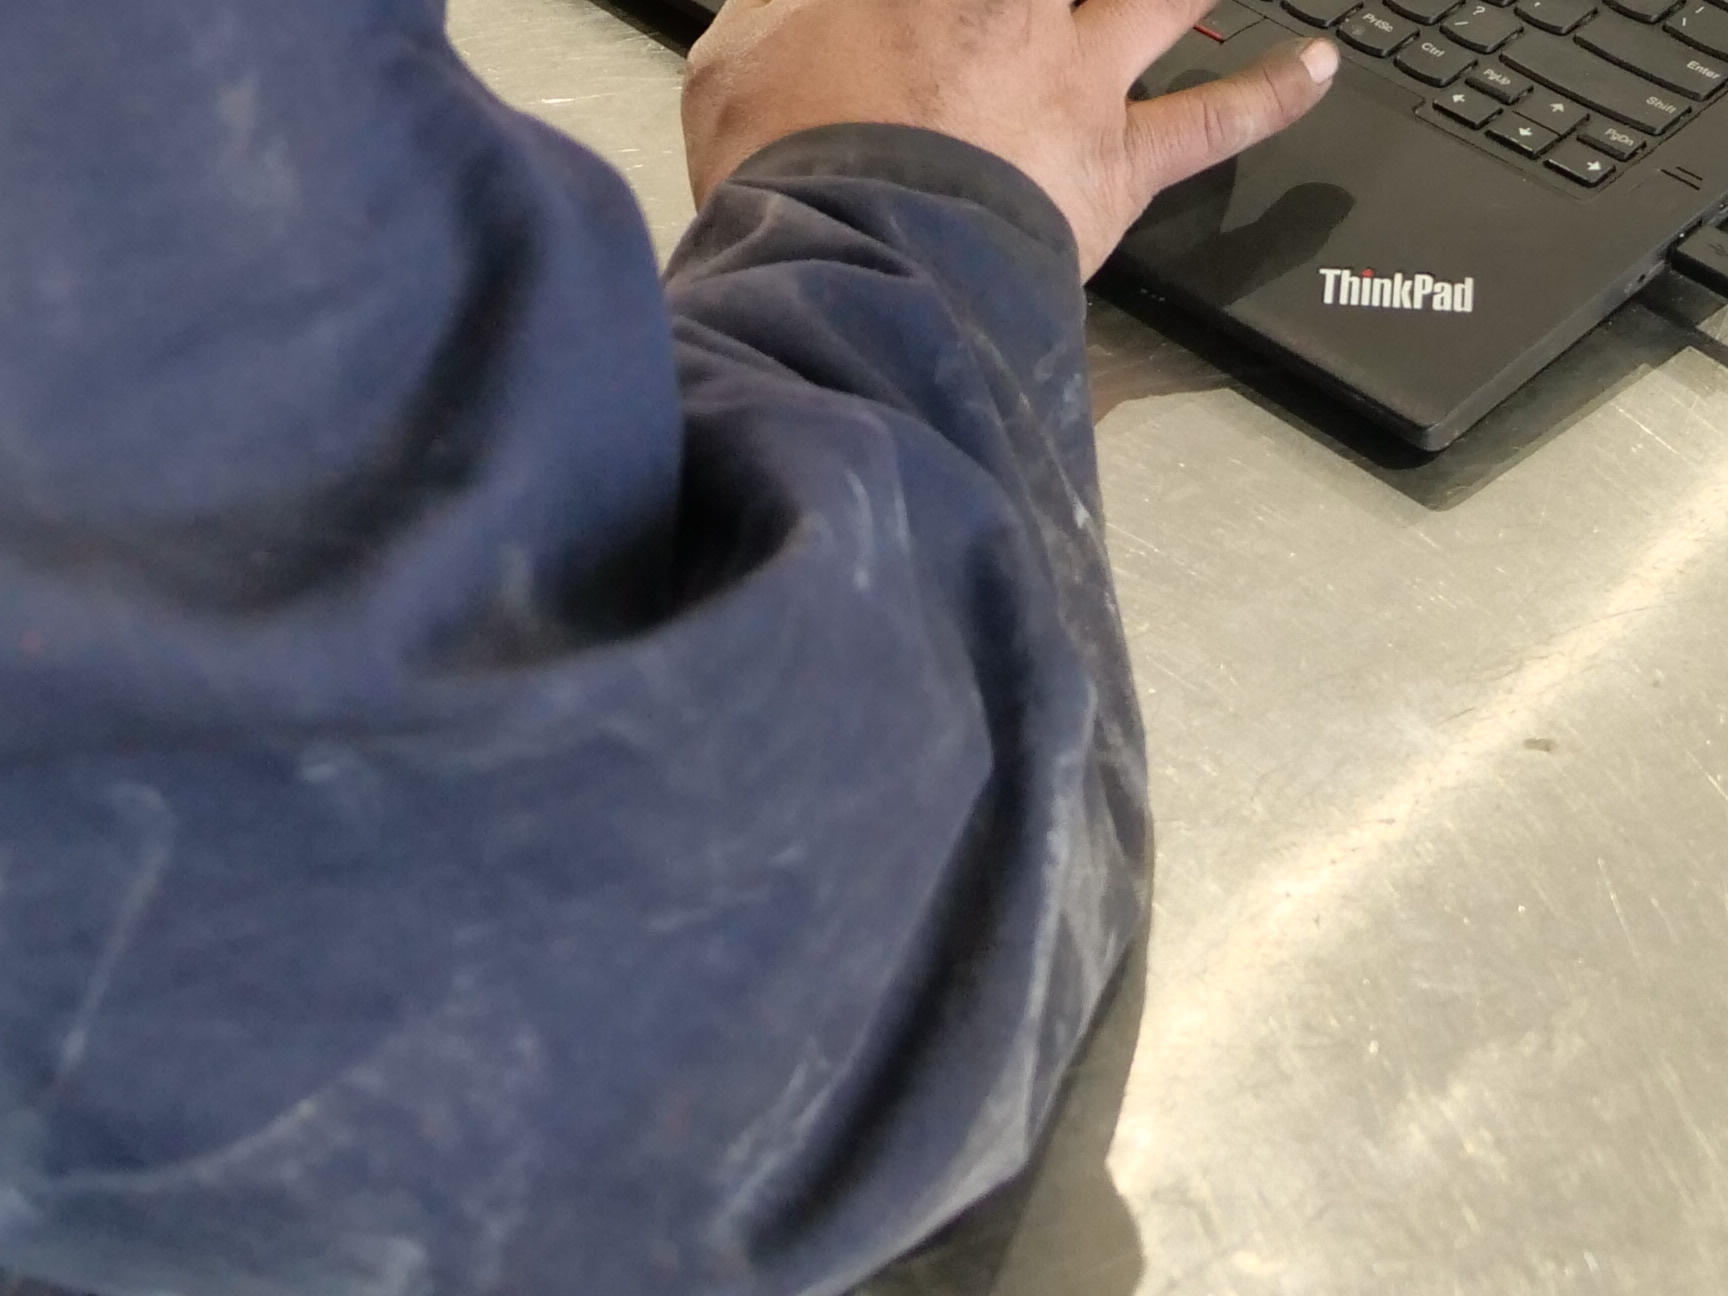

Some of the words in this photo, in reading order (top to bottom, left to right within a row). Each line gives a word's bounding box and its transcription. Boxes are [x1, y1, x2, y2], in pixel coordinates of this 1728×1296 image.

[1362, 12, 1395, 34] PrtSc
[1482, 68, 1512, 87] PgUp
[1686, 60, 1721, 81] Enter
[1646, 96, 1677, 115] Shift
[1604, 127, 1635, 148] PgDn
[1319, 268, 1474, 312] ThinkPad
